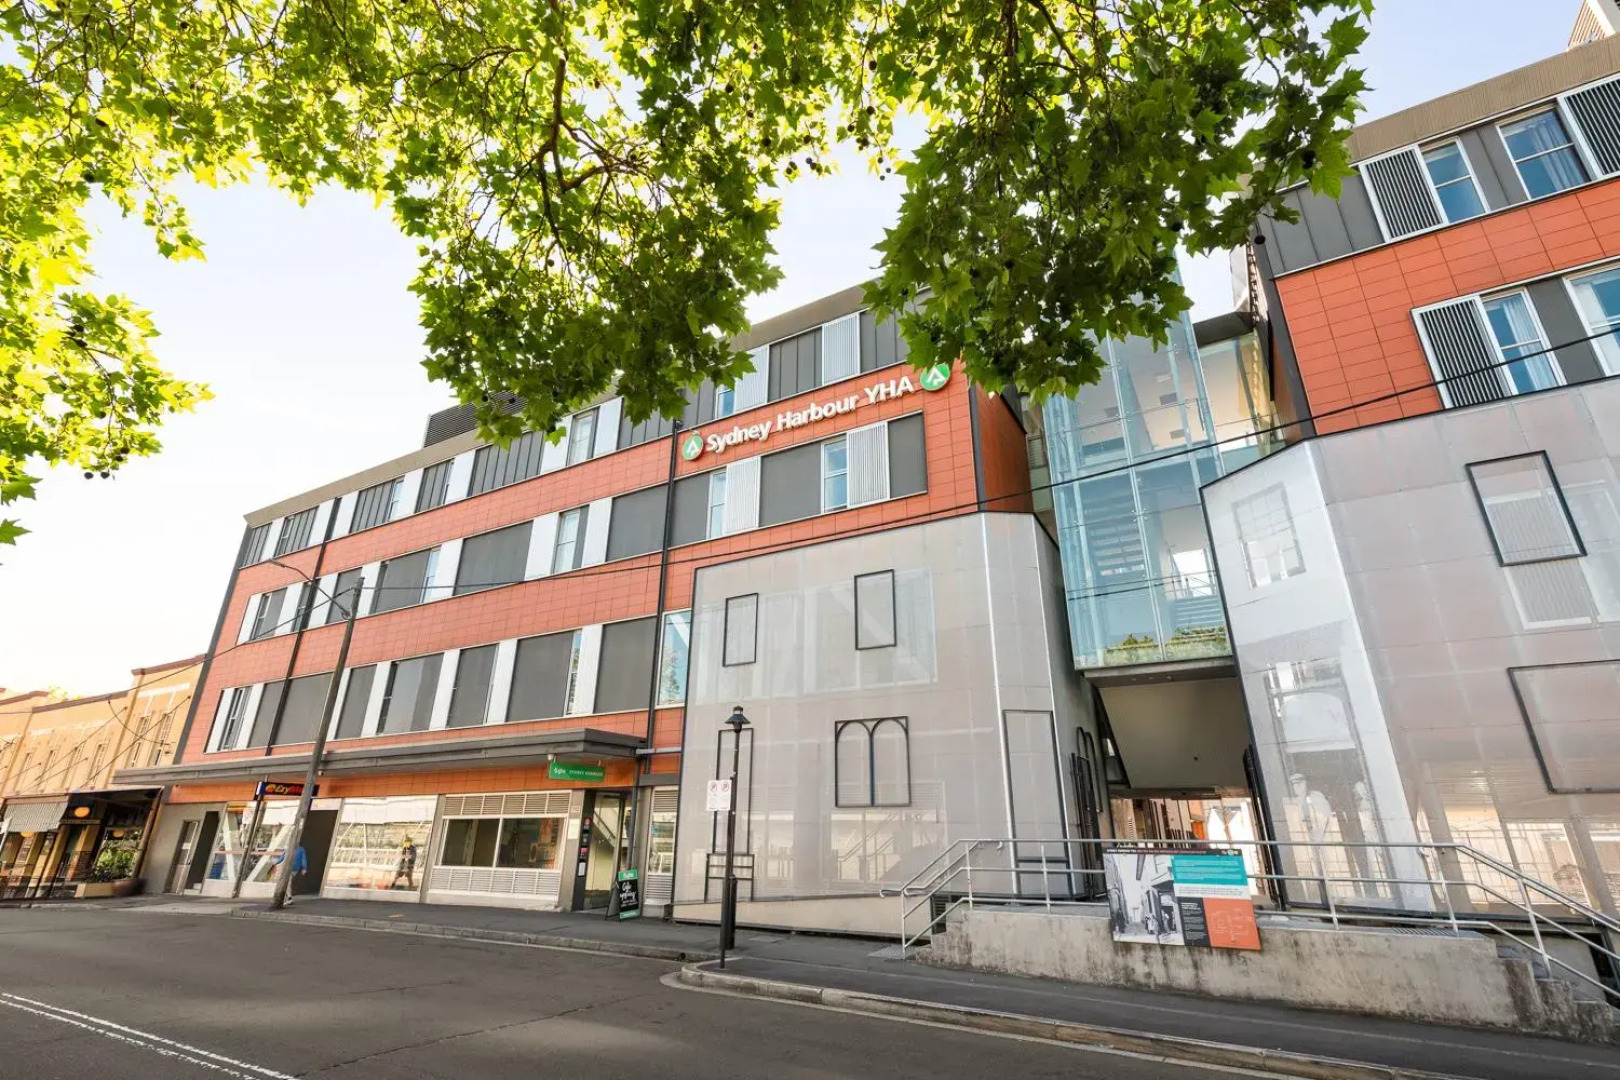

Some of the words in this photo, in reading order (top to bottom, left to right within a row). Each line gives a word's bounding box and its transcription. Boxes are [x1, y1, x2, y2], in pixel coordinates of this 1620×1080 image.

[706, 420, 771, 454] Sydney
[776, 395, 859, 430] Harbour
[864, 376, 915, 404] YHA
